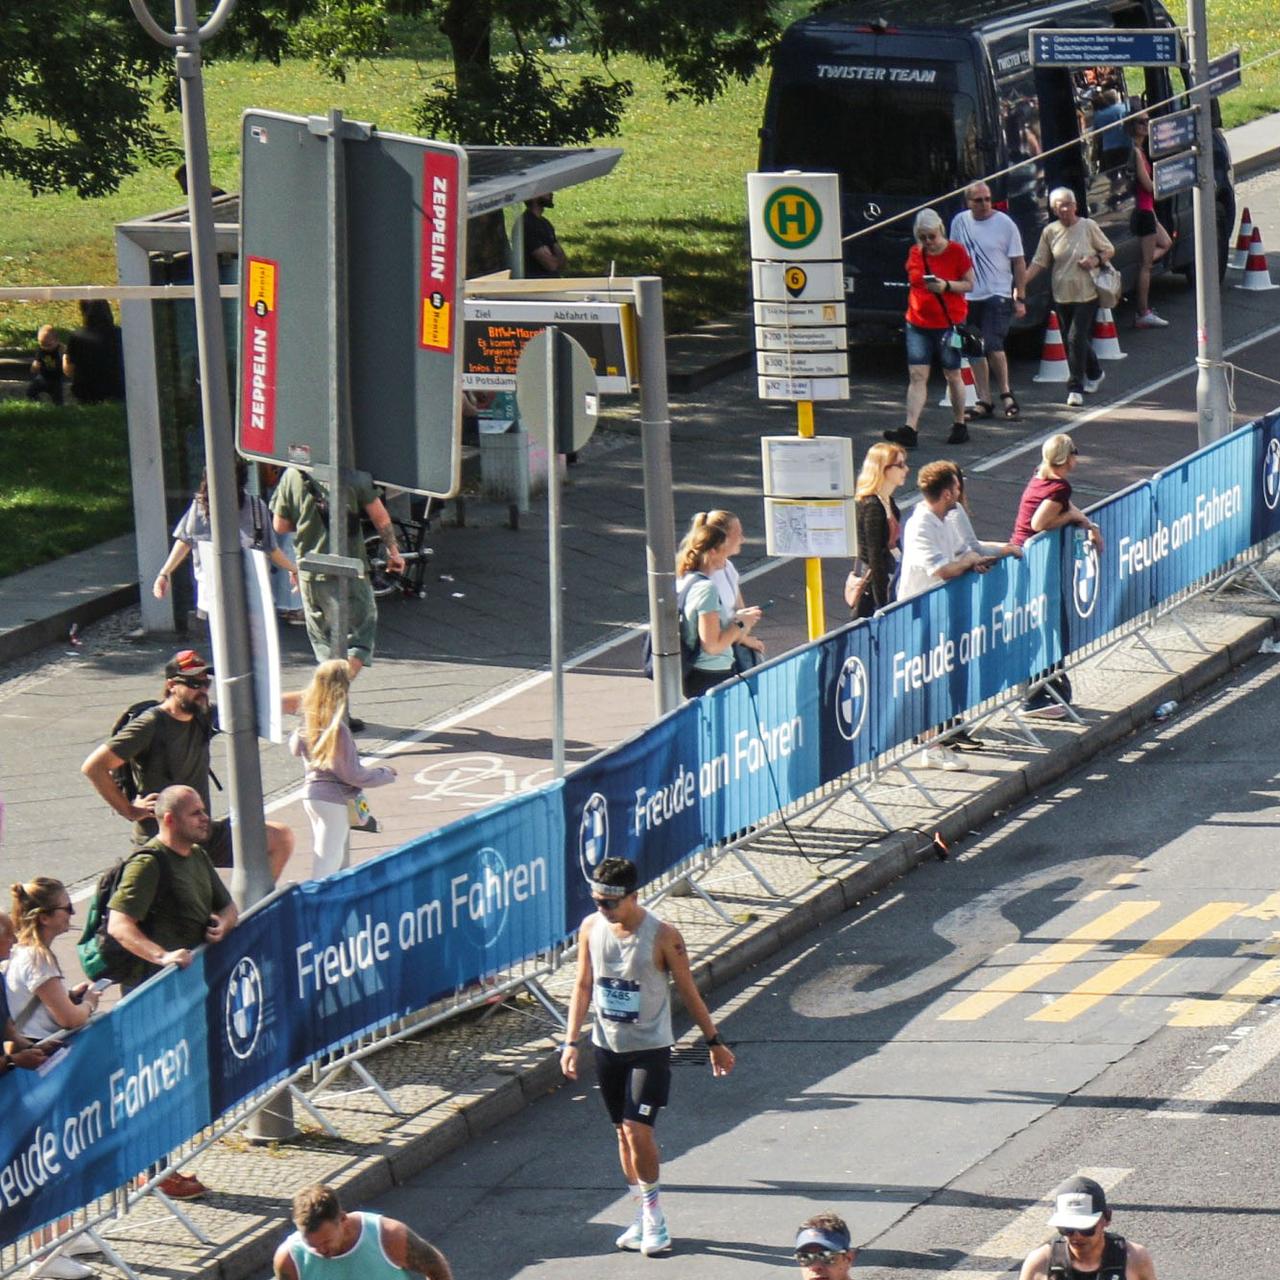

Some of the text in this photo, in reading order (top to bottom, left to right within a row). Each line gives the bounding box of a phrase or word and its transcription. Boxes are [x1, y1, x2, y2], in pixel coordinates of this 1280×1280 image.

[817, 64, 936, 83] TWISTER TEAM
[430, 176, 447, 281] ZEPPELIN
[778, 201, 807, 235] H
[475, 310, 599, 321] Ziel Abfahrt in
[792, 273, 799, 285] 6
[251, 328, 267, 431] ZEPPELIN
[1120, 484, 1241, 580] Freude am Fahren
[893, 593, 1048, 699] Freude am Fahren
[635, 716, 803, 838] Freude am Fahren
[297, 856, 546, 999] Freude am Fahren
[63, 1098, 102, 1164] am
[110, 1037, 189, 1130] Fahren
